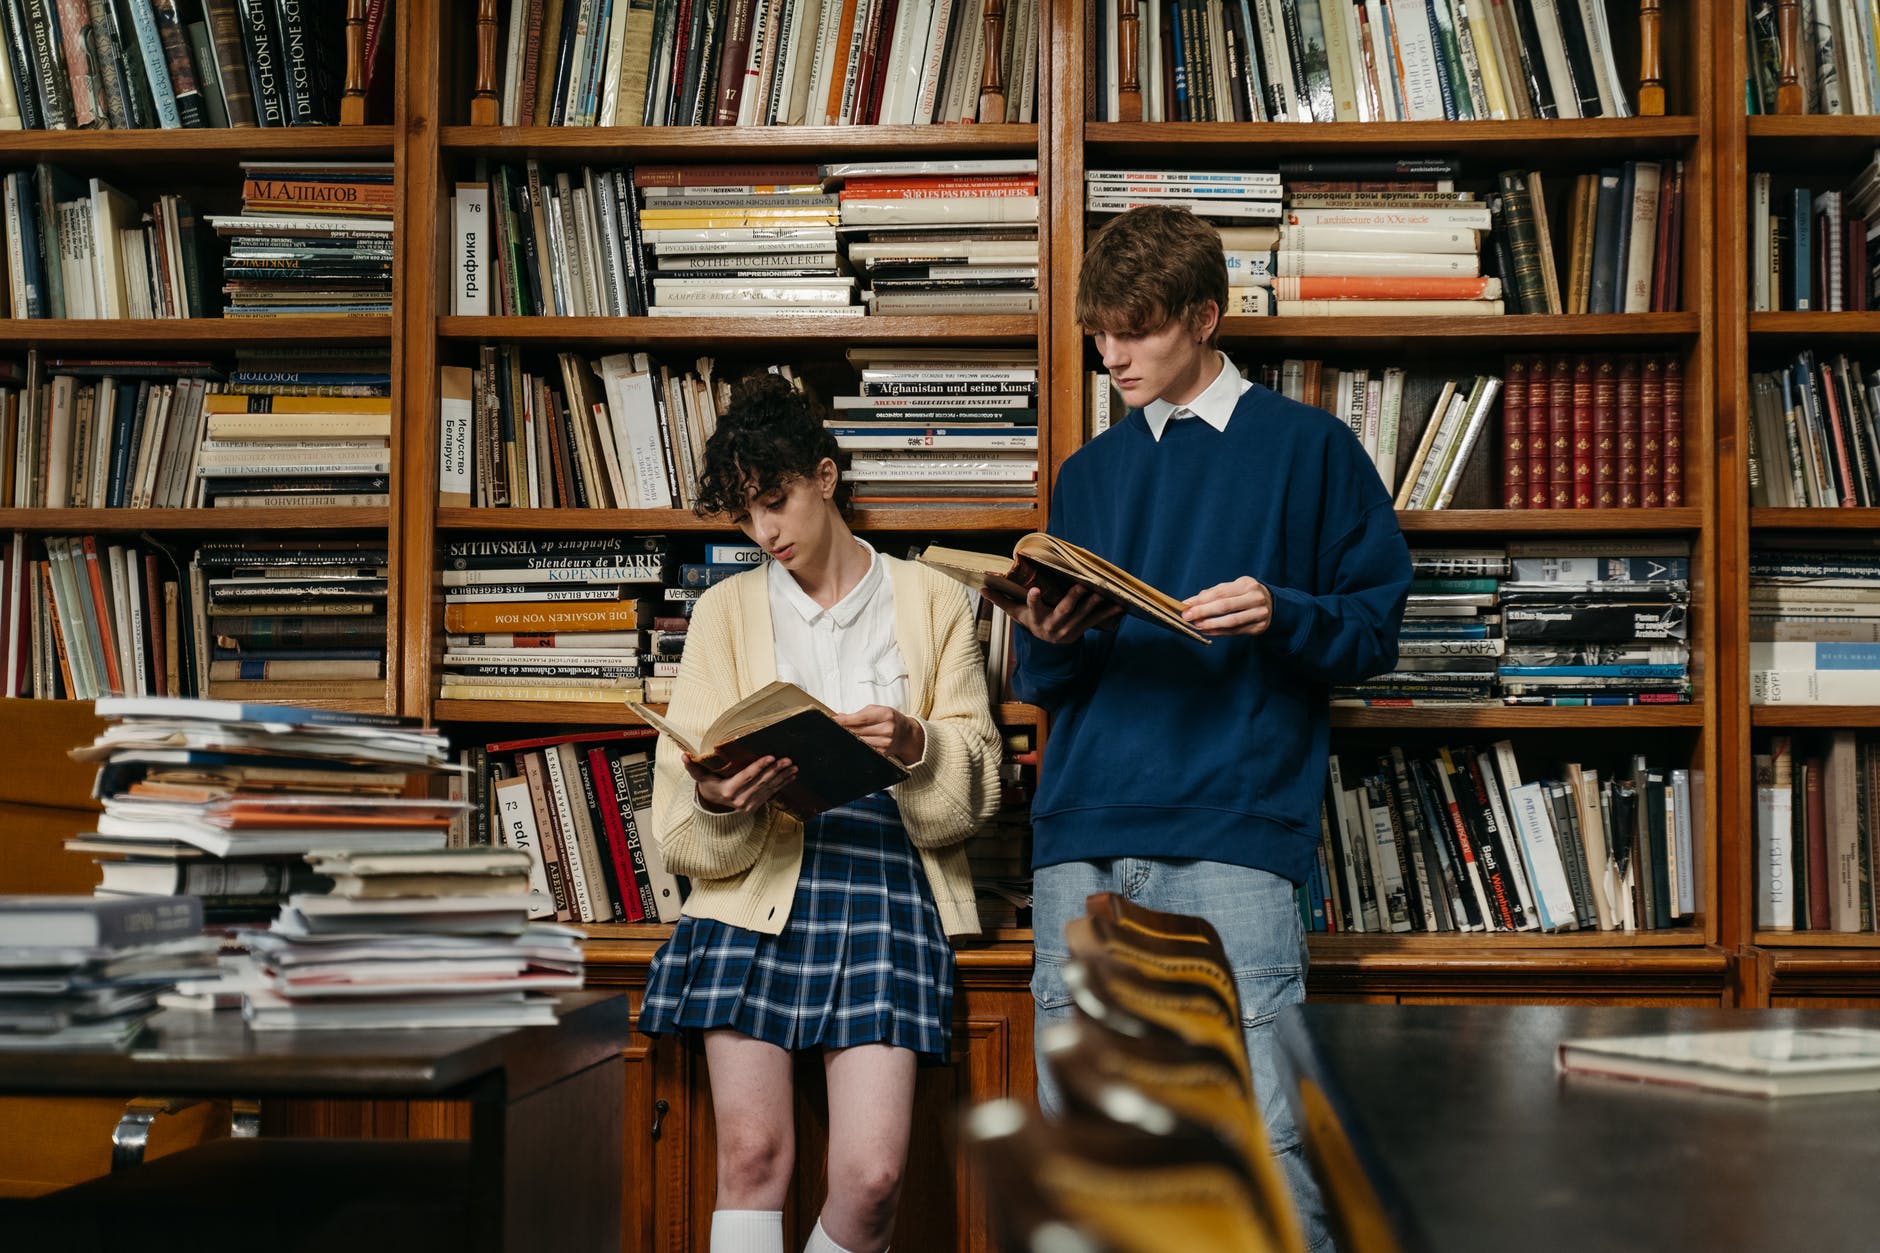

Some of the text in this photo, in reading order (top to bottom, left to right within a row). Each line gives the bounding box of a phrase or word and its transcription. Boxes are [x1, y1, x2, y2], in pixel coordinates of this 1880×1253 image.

[34, 21, 58, 106] ALTRUSSISCHE
[289, 25, 311, 114] DIE SCHÖNE
[929, 55, 940, 78] UND
[255, 34, 279, 120] DIE SCHÖNE
[810, 55, 819, 91] moderne
[1186, 73, 1194, 96] Москва
[1196, 74, 1204, 97] Москва
[726, 87, 737, 101] 17
[841, 78, 855, 117] Studenten
[923, 80, 936, 115] ORDEN
[253, 182, 357, 201] М.АЛПАТОВ
[902, 188, 1029, 200] SUR LES PAS DES TEMPLIERS
[469, 204, 481, 213] 76
[1316, 216, 1372, 225] L'architecture
[1374, 216, 1384, 225] du
[232, 259, 299, 268] PANKIEWICZ
[463, 232, 478, 298] графика
[880, 382, 1032, 396] Afghanistan und seine Kunst
[1352, 381, 1365, 411] HOME
[1097, 378, 1108, 429] UND PLÄTZE
[444, 420, 455, 472] Беларуси
[457, 419, 467, 474] Искусство
[1388, 430, 1397, 455] design
[240, 466, 274, 474] ENGLISH
[264, 498, 336, 506] ВЕНЕЦИАНОВ
[450, 539, 622, 556] Splendeurs de VERSAILLES
[528, 554, 662, 570] Splendeurs de PARIS
[1780, 566, 1823, 575] Städtebau
[548, 567, 654, 581] KOPENHAGEN
[450, 585, 525, 595] DAS GEGENBILD
[547, 592, 580, 600] BILANG
[495, 611, 627, 624] DIE MOSAIKEN VON ROM
[1440, 640, 1498, 656] SCARPA
[480, 666, 499, 674] Loire
[508, 666, 519, 674] de
[520, 666, 556, 676] Châteaux
[558, 666, 599, 676] Merveilleux
[1755, 674, 1762, 683] OF
[1772, 671, 1780, 701] EGYPT
[505, 801, 518, 811] 73
[610, 759, 647, 874] Les Rois de France
[1483, 809, 1498, 833] Bach
[548, 750, 590, 919] HORNIG LEIPZIGER PLAKATKUNST
[1480, 845, 1497, 869] Bach
[614, 902, 622, 916] SUN
[640, 887, 652, 918] COLLECTION
